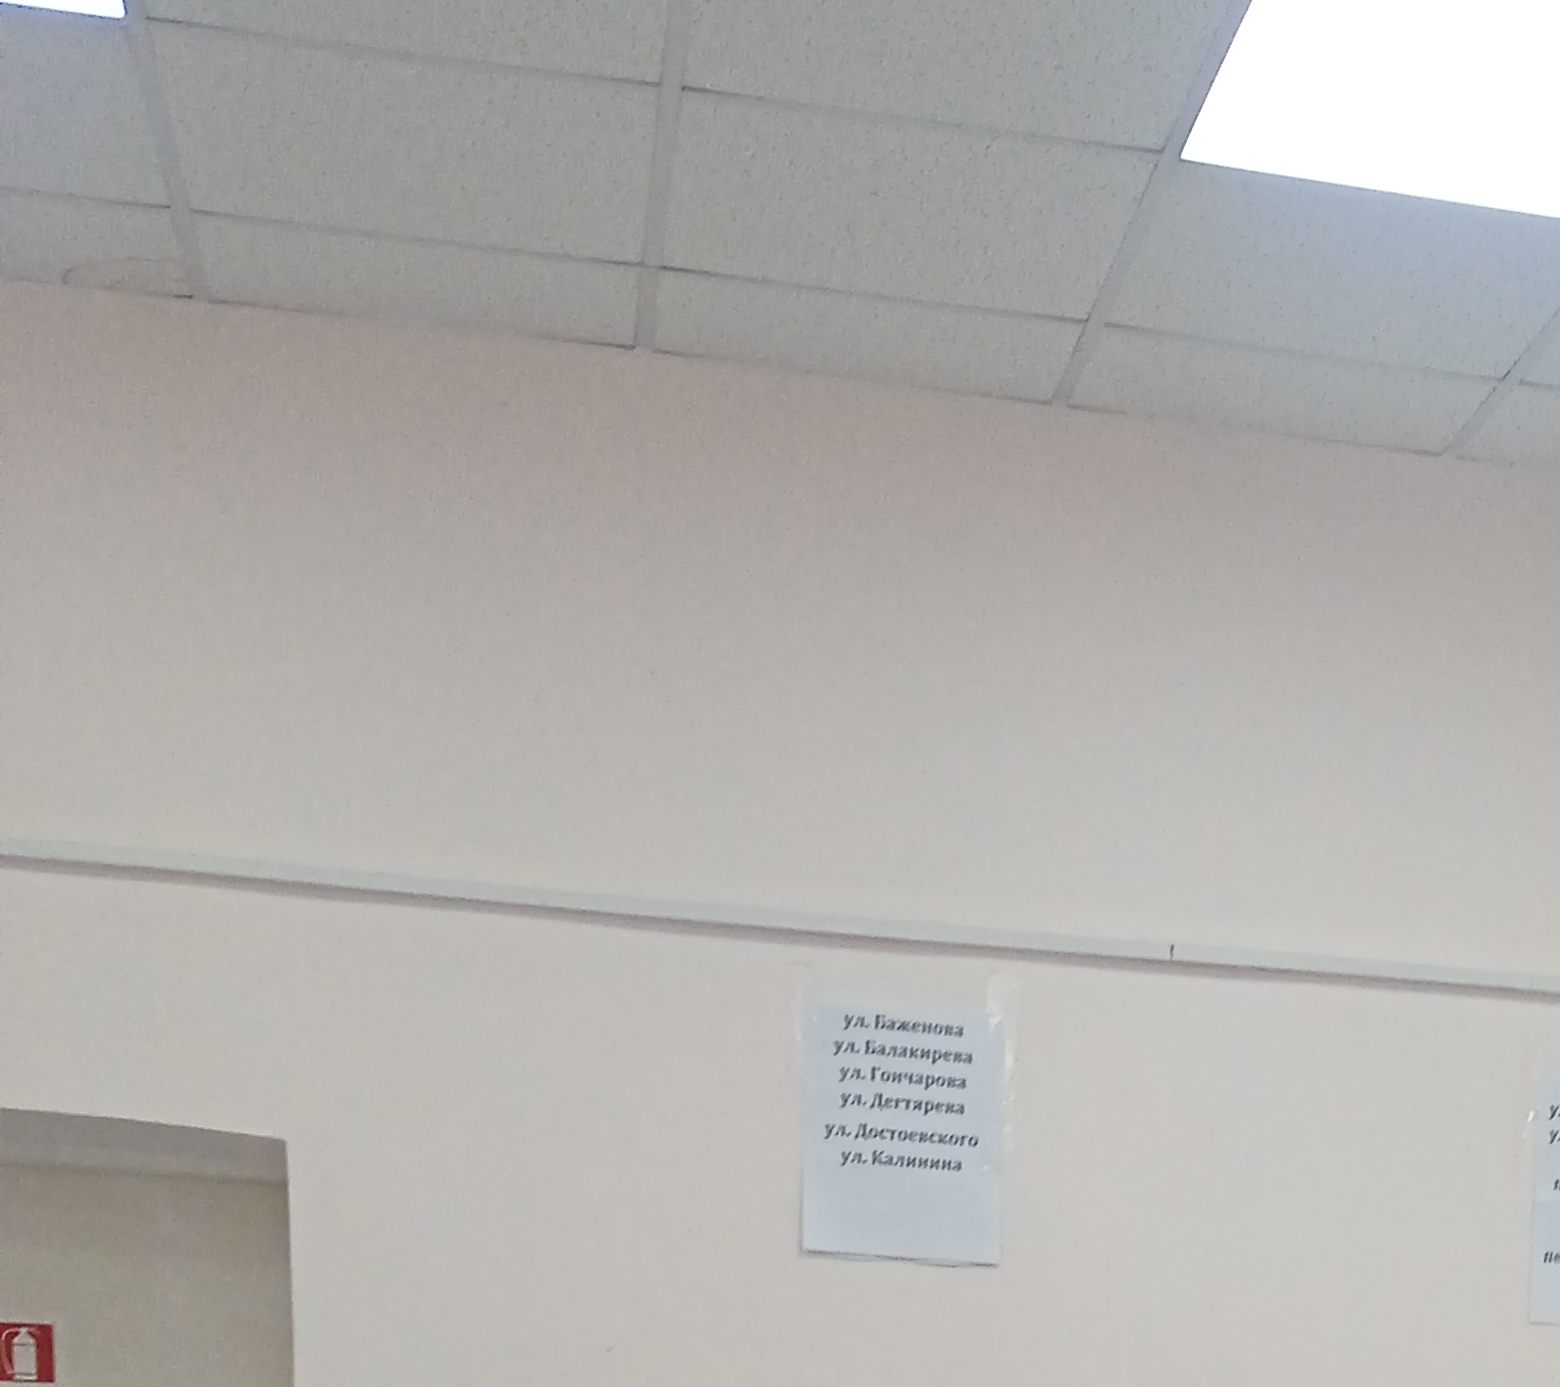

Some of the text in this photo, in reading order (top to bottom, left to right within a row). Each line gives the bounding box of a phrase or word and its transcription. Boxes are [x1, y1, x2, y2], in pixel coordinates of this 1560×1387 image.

[843, 1012, 964, 1037] ул. Баженова
[832, 1039, 972, 1064] ул. Балакирева
[838, 1065, 966, 1089] ул. Гончарова
[839, 1091, 866, 1108] ул.
[823, 1121, 978, 1147] ул. Достоевского
[839, 1149, 962, 1172] ул. Калинина
